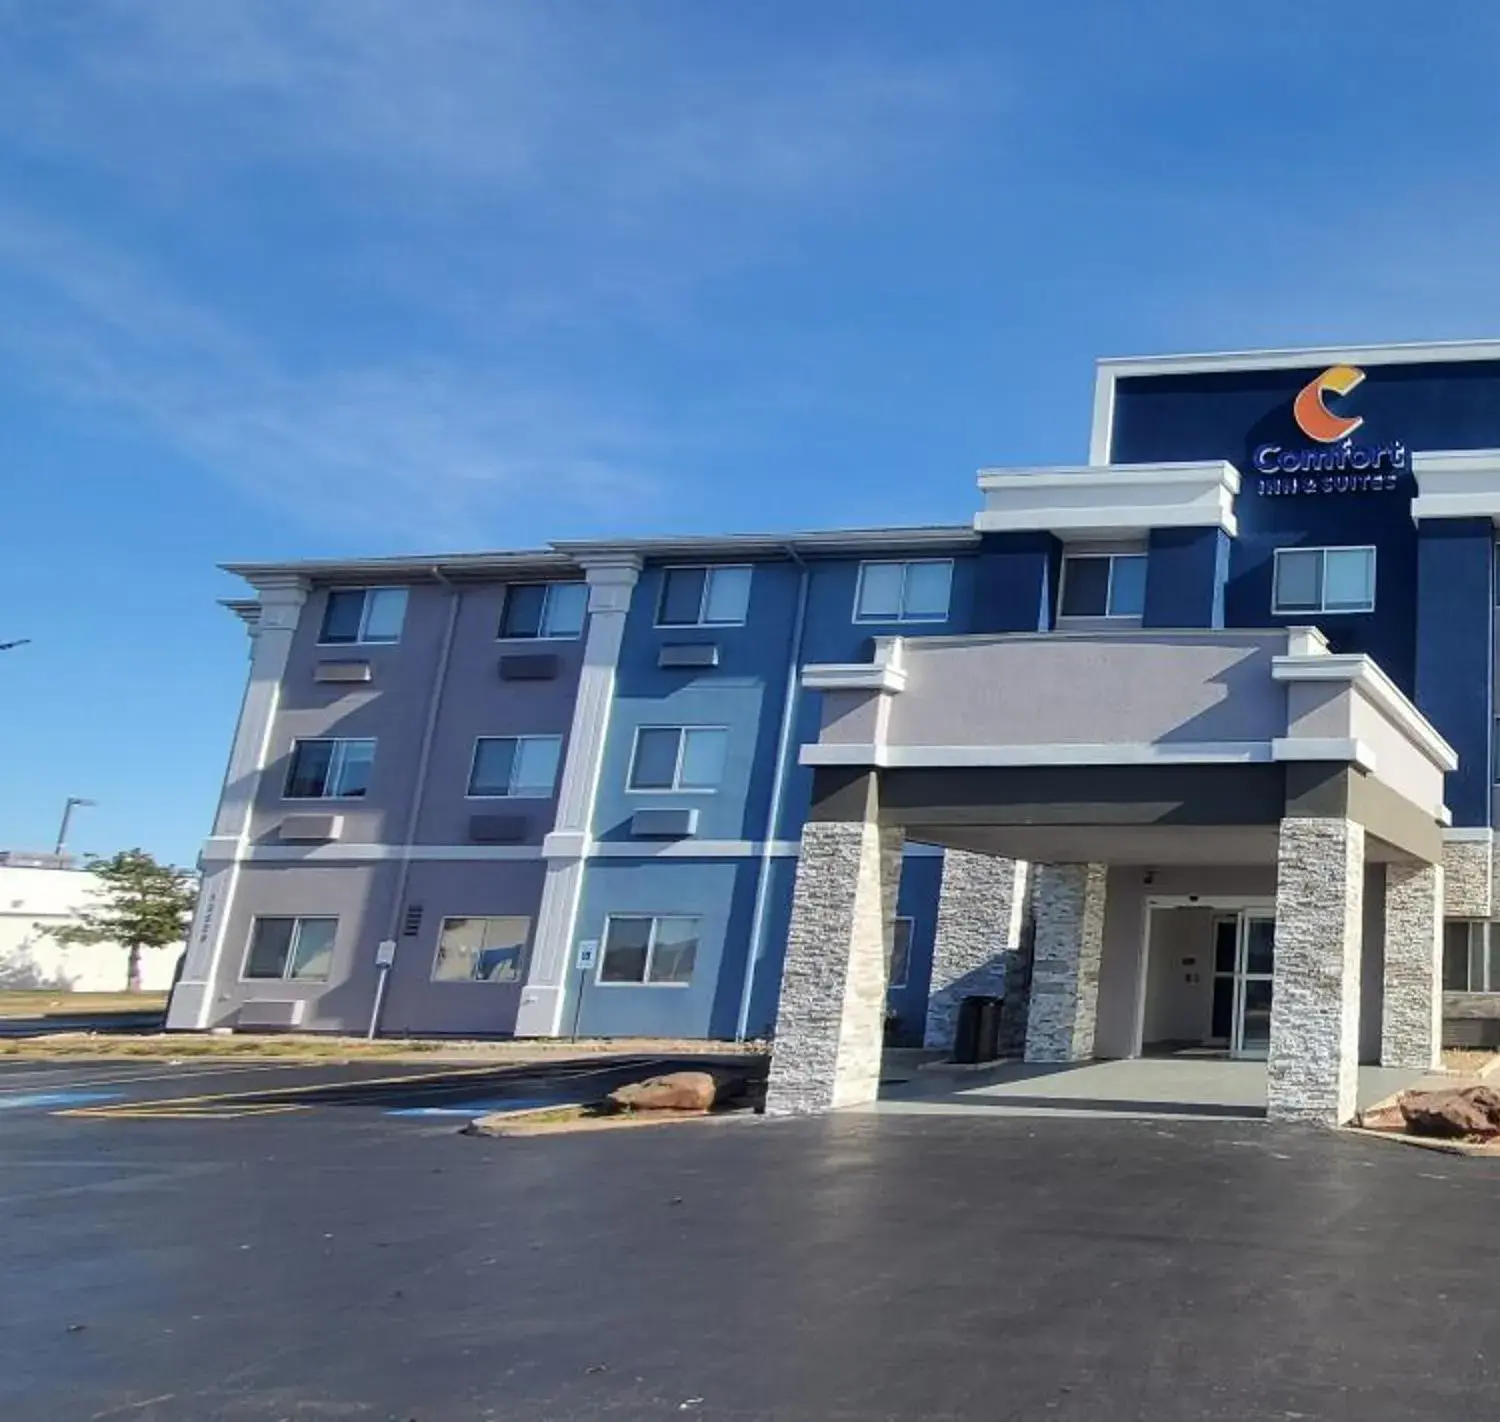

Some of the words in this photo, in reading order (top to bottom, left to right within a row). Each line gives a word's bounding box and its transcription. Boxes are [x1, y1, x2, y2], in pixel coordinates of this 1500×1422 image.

[1254, 438, 1406, 474] Comfort
[1258, 477, 1298, 496] INN
[1303, 477, 1318, 494] &
[1321, 474, 1397, 493] SUITES
